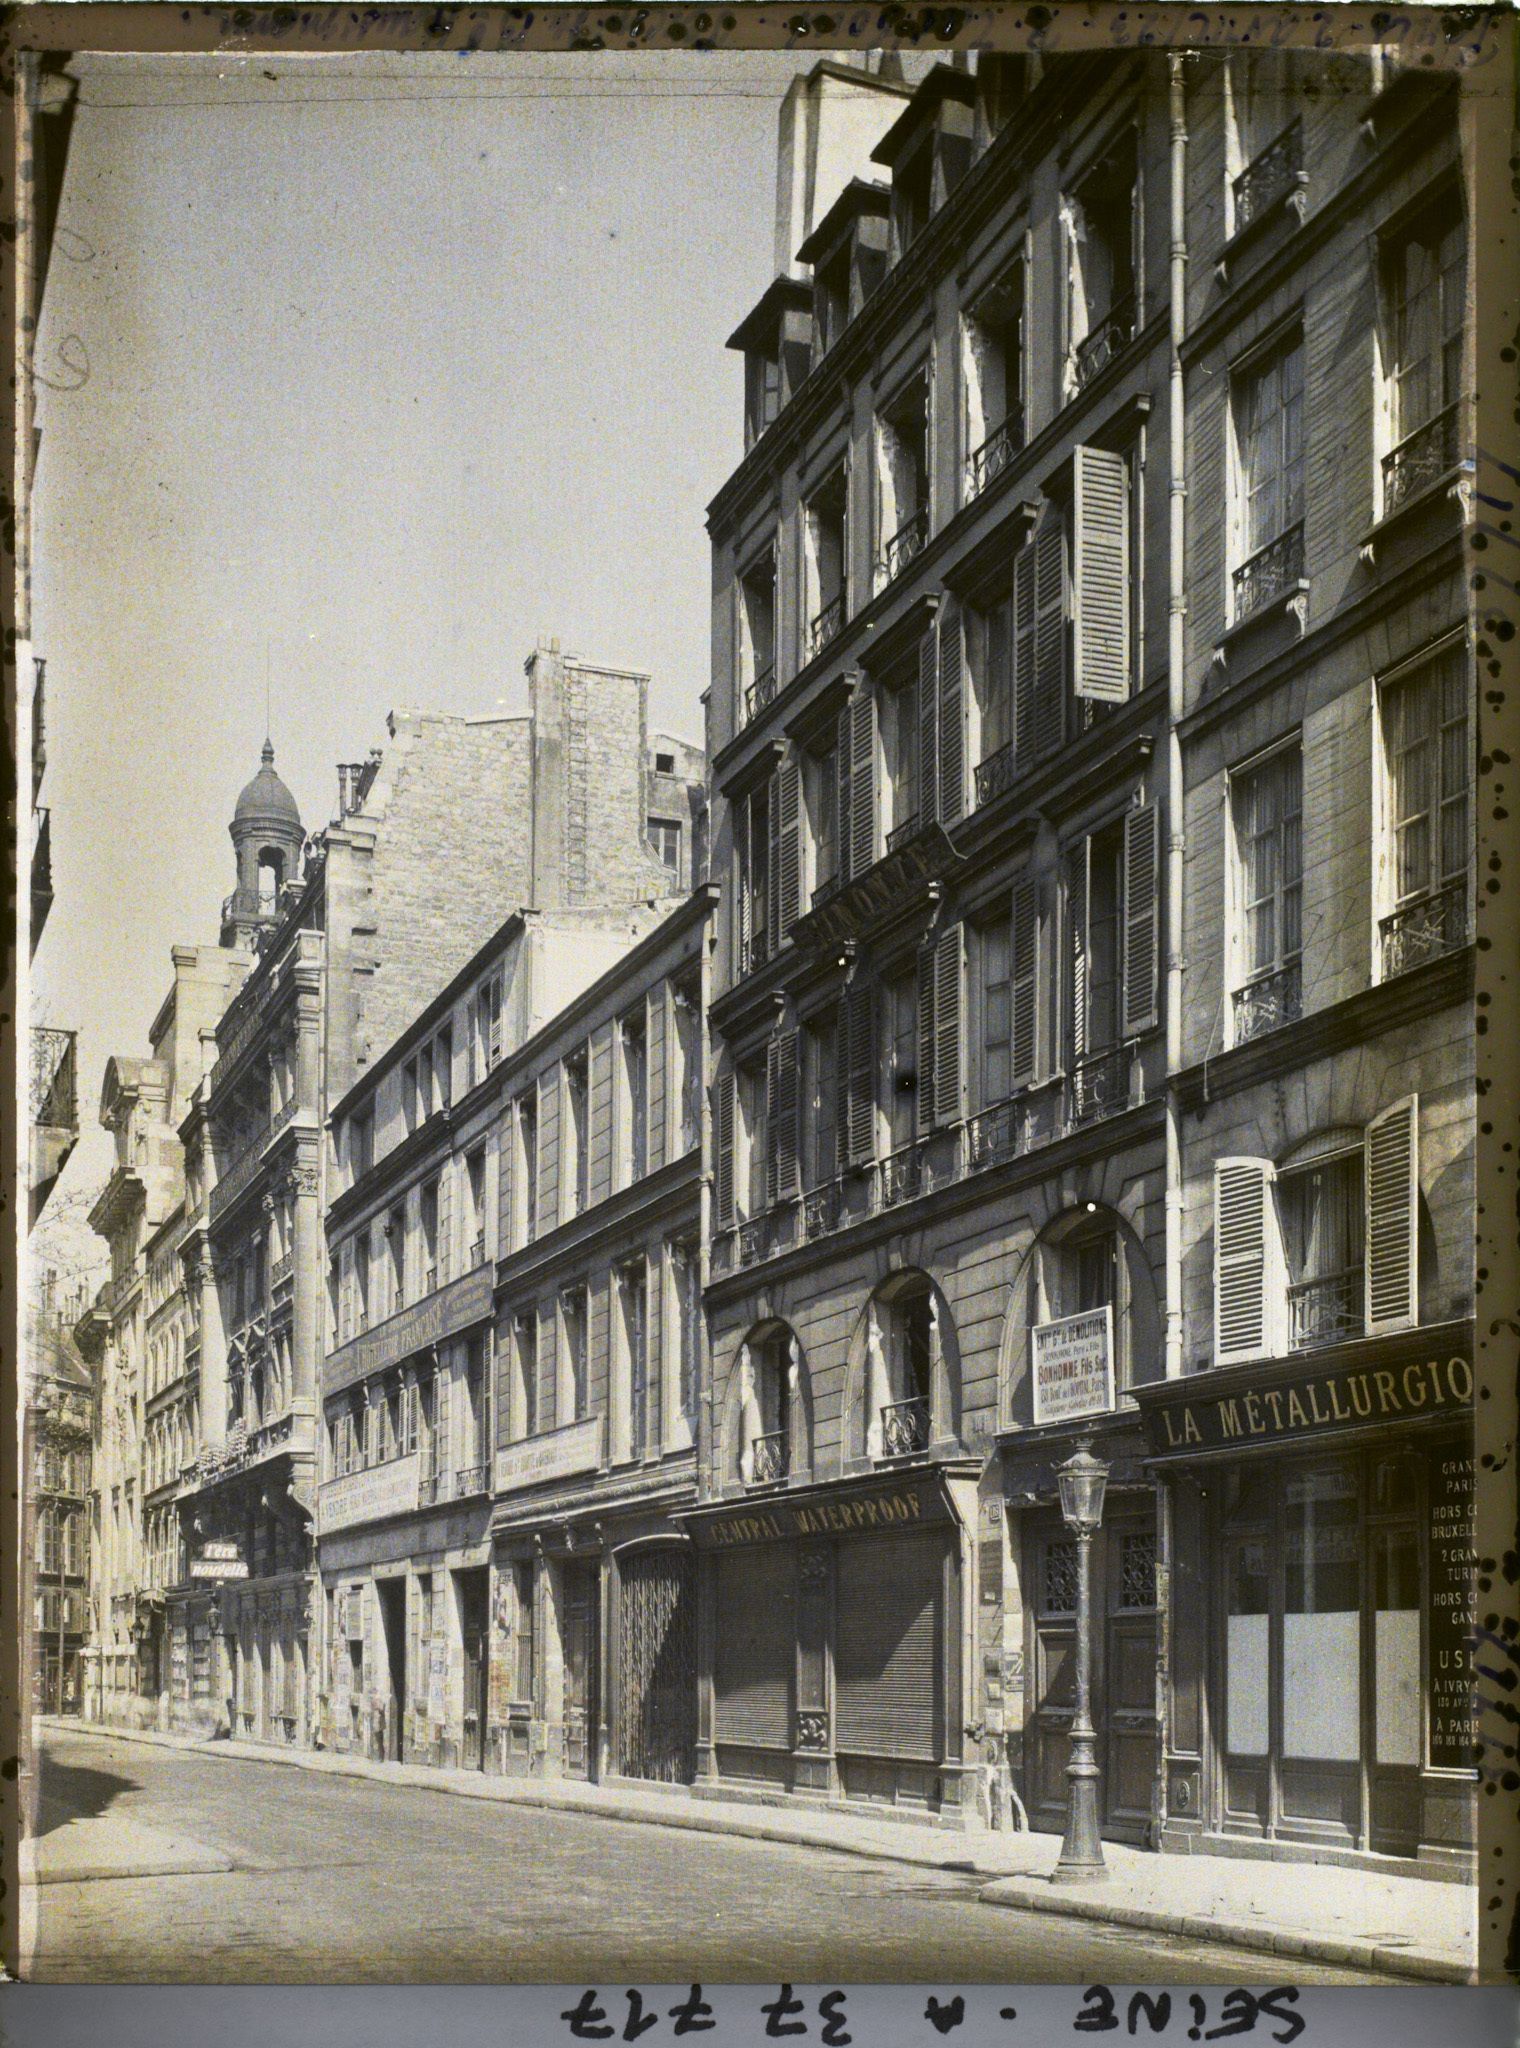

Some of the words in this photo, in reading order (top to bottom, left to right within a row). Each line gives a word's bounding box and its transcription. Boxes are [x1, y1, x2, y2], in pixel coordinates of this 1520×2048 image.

[1038, 1359, 1078, 1386] BONHOMME
[1162, 1408, 1202, 1447] LA
[1220, 1356, 1474, 1438] MÉTALLURGIQ
[711, 1514, 784, 1544] CENTRAL
[793, 1493, 921, 1534] WATERPROOF
[1432, 1505, 1461, 1519] HORS
[1433, 1592, 1461, 1606] HORS
[1444, 1680, 1471, 1693] IVRY
[1449, 1719, 1479, 1733] PARIS
[561, 1984, 716, 2042] 717
[761, 1984, 852, 2047] 37
[925, 1996, 966, 2034] A
